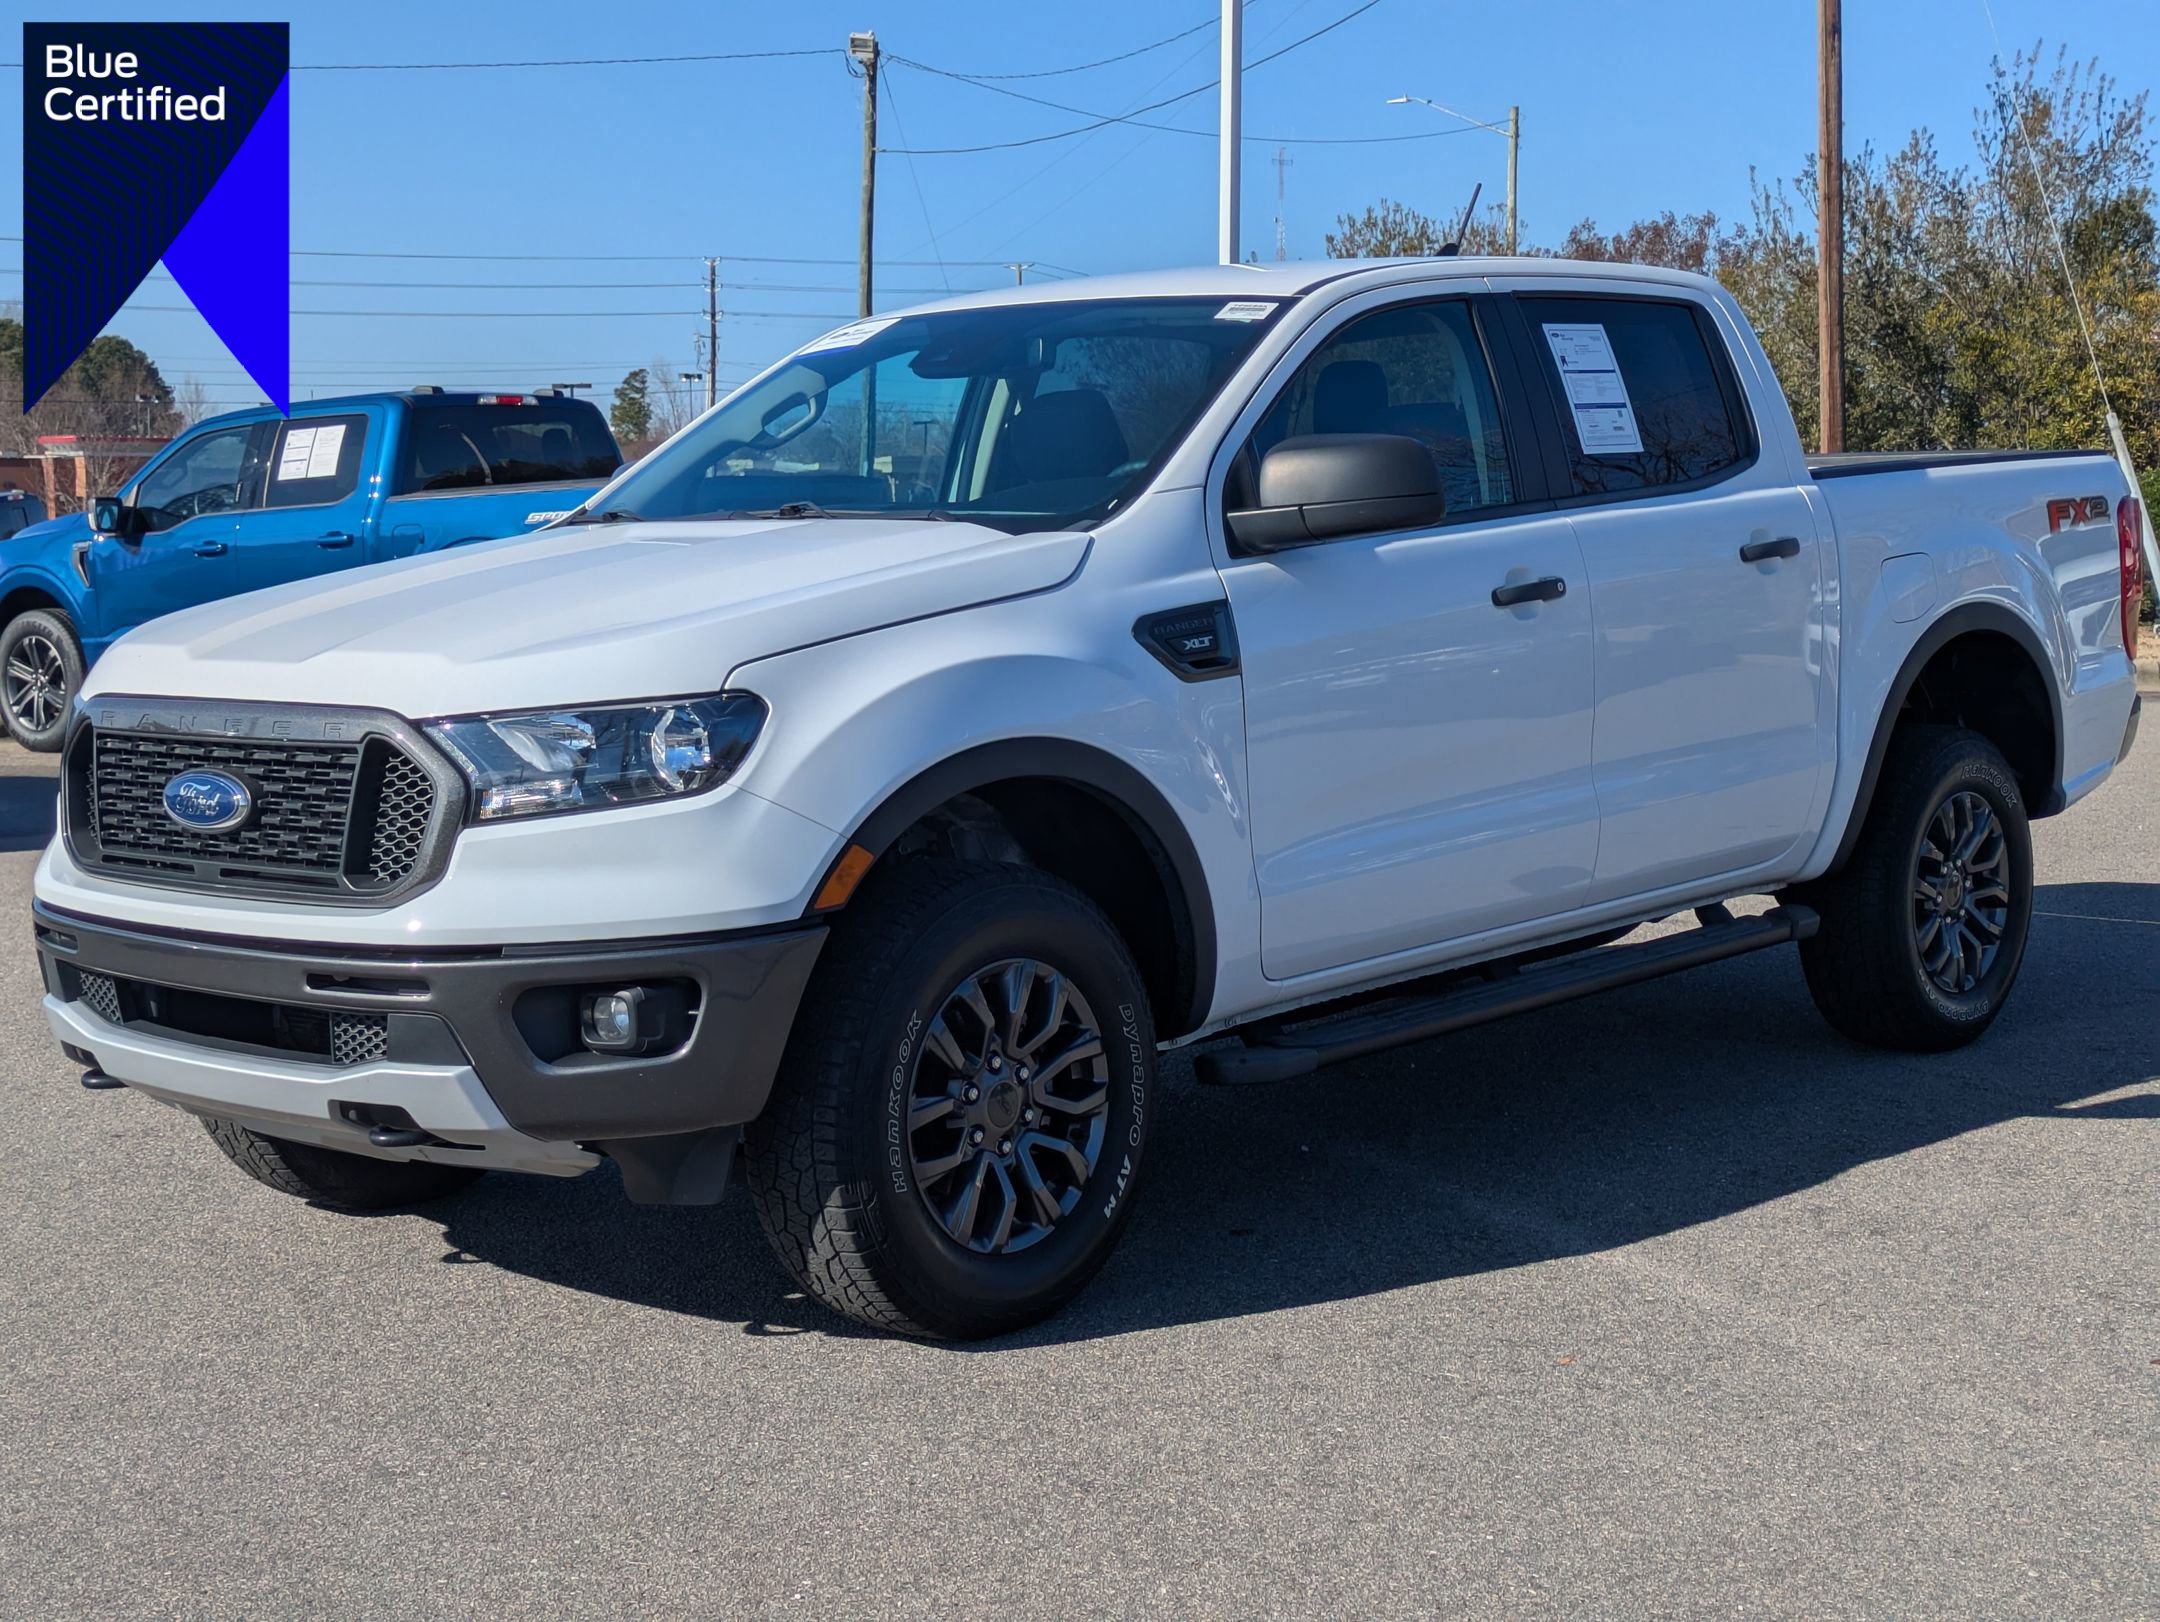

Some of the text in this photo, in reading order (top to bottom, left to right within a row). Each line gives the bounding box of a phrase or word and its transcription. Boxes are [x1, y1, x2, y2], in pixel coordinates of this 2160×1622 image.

[2047, 495, 2112, 533] FX2
[1183, 635, 1214, 651] XLT
[101, 710, 345, 738] RANGER
[175, 782, 221, 816] Ford
